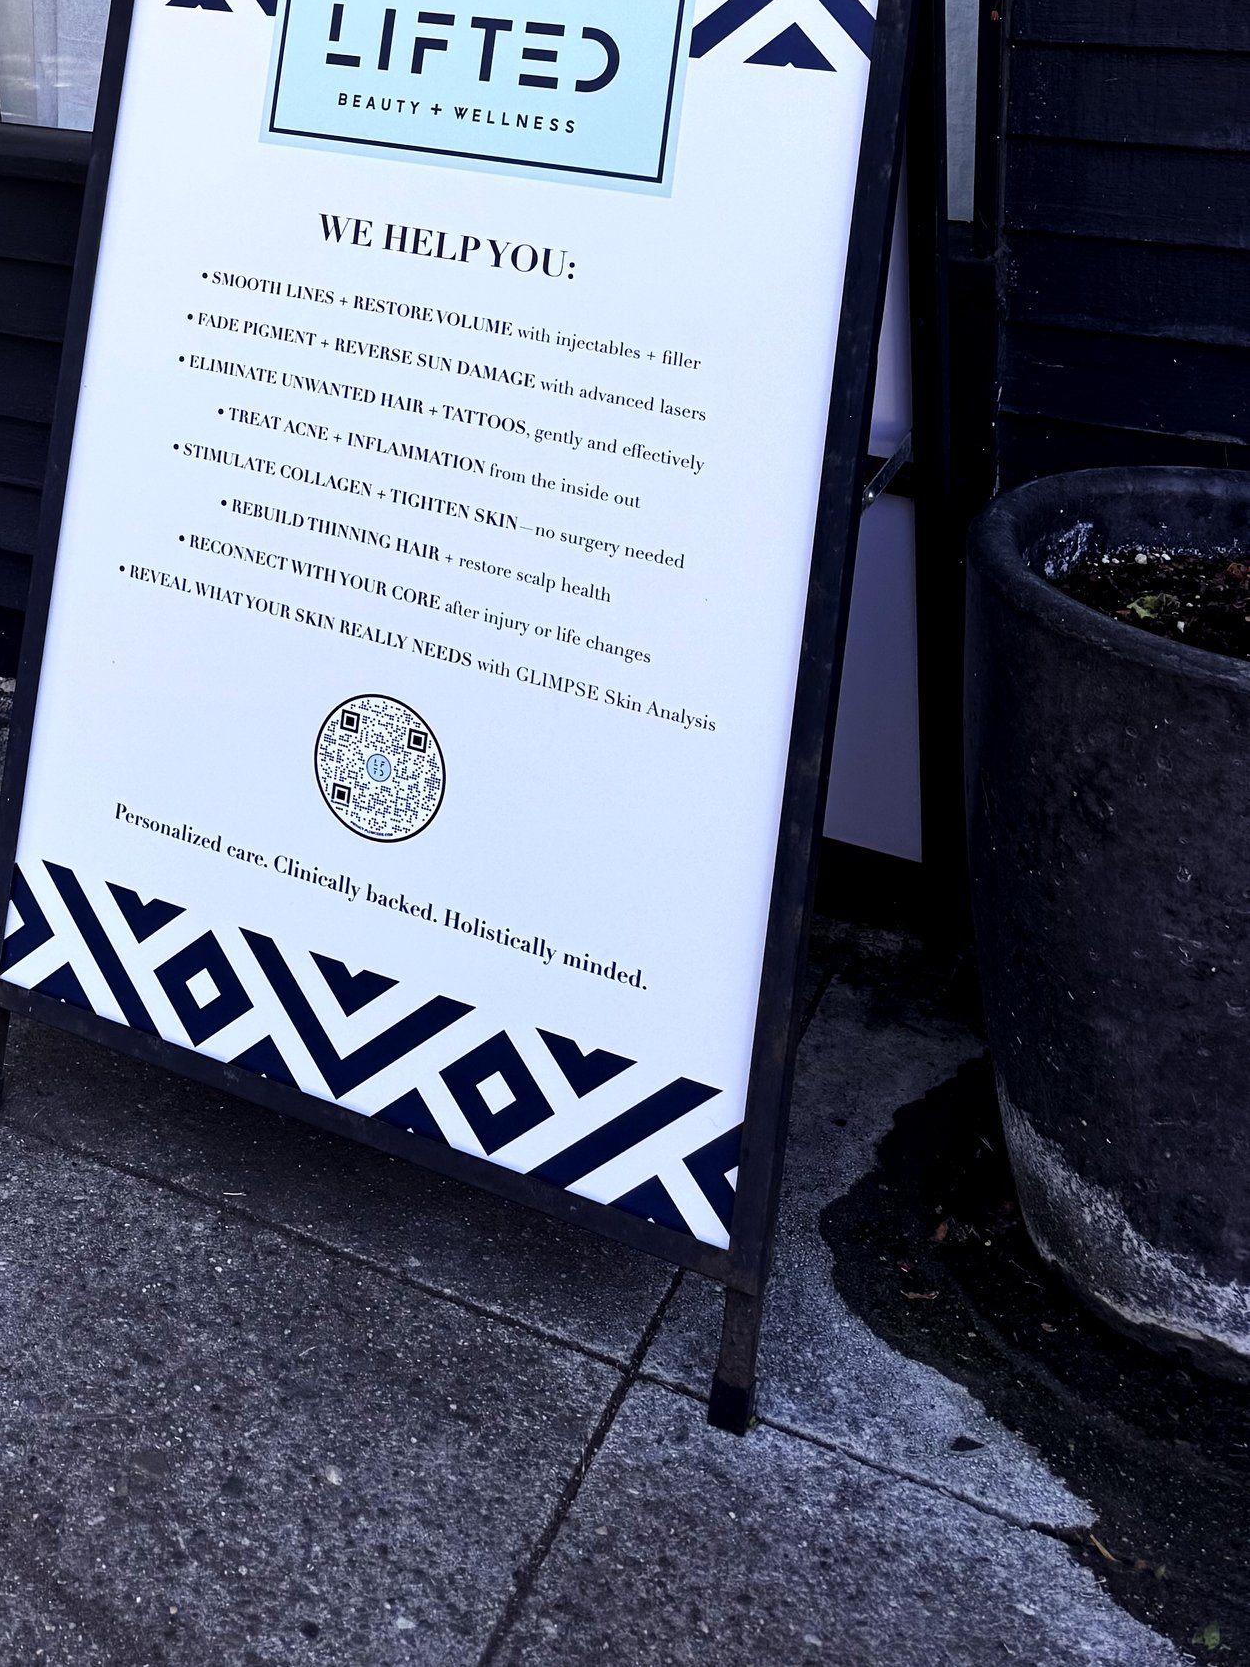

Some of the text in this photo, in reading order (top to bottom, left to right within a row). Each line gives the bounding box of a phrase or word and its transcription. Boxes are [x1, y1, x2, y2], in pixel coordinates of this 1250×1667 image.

[326, 3, 620, 93] LIFTED
[338, 93, 420, 114] BEAUTY
[454, 106, 575, 133] WELLNESS
[318, 213, 575, 279] WE HELP YOU:
[198, 312, 239, 332] FADE
[243, 321, 317, 346] PIGMENT
[335, 338, 412, 365] REVERSE
[417, 353, 452, 372] SUN
[456, 360, 535, 388] DAMAGE
[541, 379, 573, 396] with
[579, 386, 654, 411] advanced
[660, 398, 706, 421] lasers
[212, 271, 281, 295] SMOOTH
[286, 284, 334, 304] LINES
[353, 295, 433, 322] RESTORE
[436, 310, 512, 336] VOLUME
[518, 326, 550, 343] with
[556, 331, 640, 359] injectables
[662, 350, 701, 369] filler
[190, 355, 277, 384] ELIMINATE
[282, 373, 376, 403] UNWANTED
[381, 393, 423, 414] HAIR
[443, 405, 530, 438] TATTOOS,
[534, 429, 583, 450] gently
[587, 439, 617, 453] and
[623, 443, 705, 475] effectively
[229, 407, 281, 430] TREAT
[283, 420, 328, 441] ACNE
[347, 432, 486, 474] INFLAMMATION
[489, 463, 525, 484] from
[532, 472, 556, 490] the
[561, 478, 608, 501] inside
[614, 495, 641, 508] out
[183, 443, 276, 475] STIMULATE
[280, 465, 372, 497] COLLAGEN
[390, 488, 470, 519] TIGHTEN
[560, 532, 620, 558] surgery
[625, 547, 684, 569] needed
[232, 499, 304, 527] REBUILD
[307, 516, 390, 549] THINNING
[395, 537, 440, 561] HAIR
[459, 558, 511, 578] restore
[516, 572, 555, 593] scalp
[561, 577, 610, 602] health
[130, 564, 715, 731] REVEAL WHAT YOUR SKIN REALLY NEEDS with GLIMPSE Skin Analysis
[190, 534, 650, 663] RECONNECT WITH YOUR CORE after injury or life changes
[115, 802, 647, 990] Personalized care. Clinically backed. Holistically minded.
